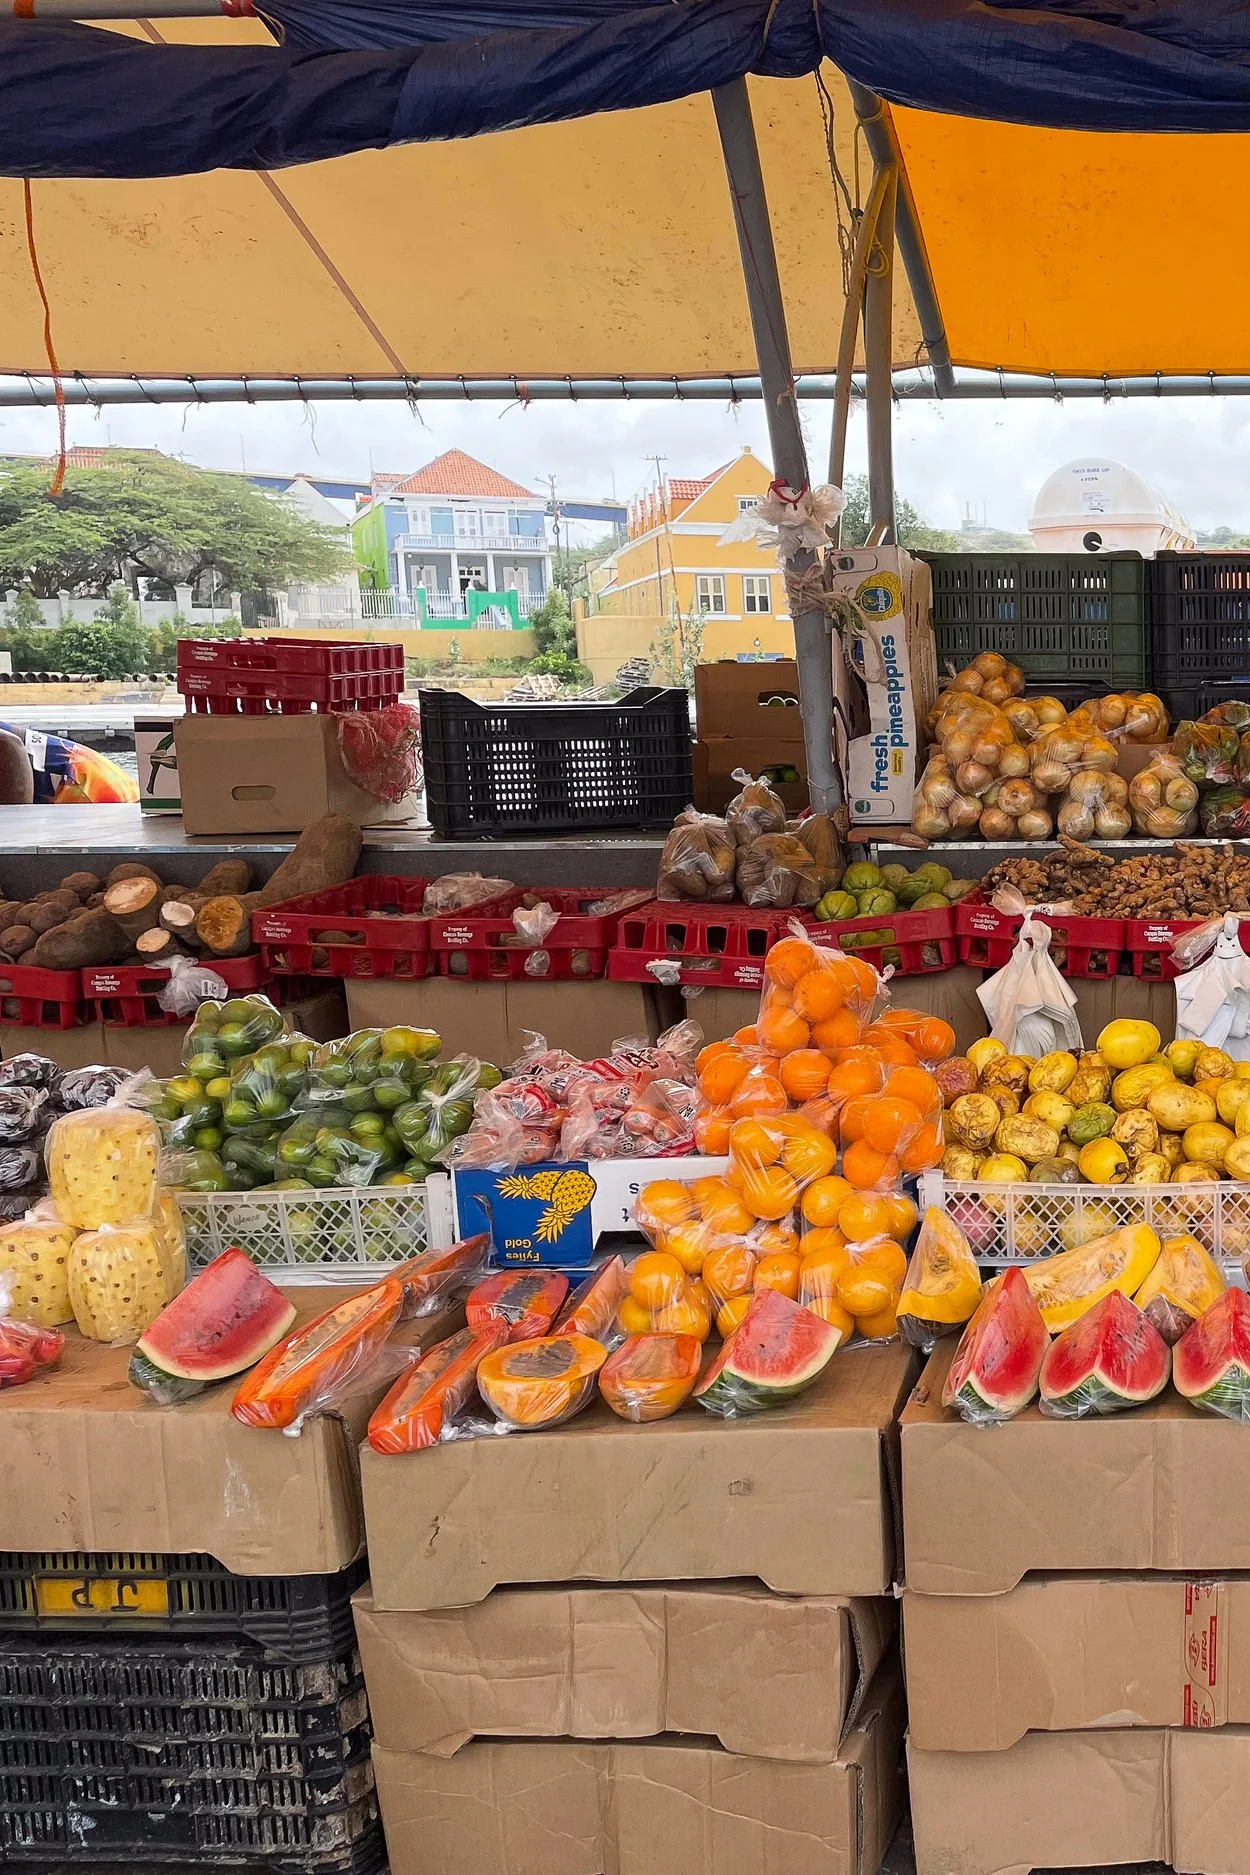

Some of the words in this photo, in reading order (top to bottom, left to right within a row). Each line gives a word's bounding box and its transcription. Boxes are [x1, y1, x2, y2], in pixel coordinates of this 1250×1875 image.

[881, 634, 909, 747] pineapples
[870, 735, 889, 793] fresh
[504, 1239, 532, 1249] Gold
[505, 1250, 540, 1262] Fyffes
